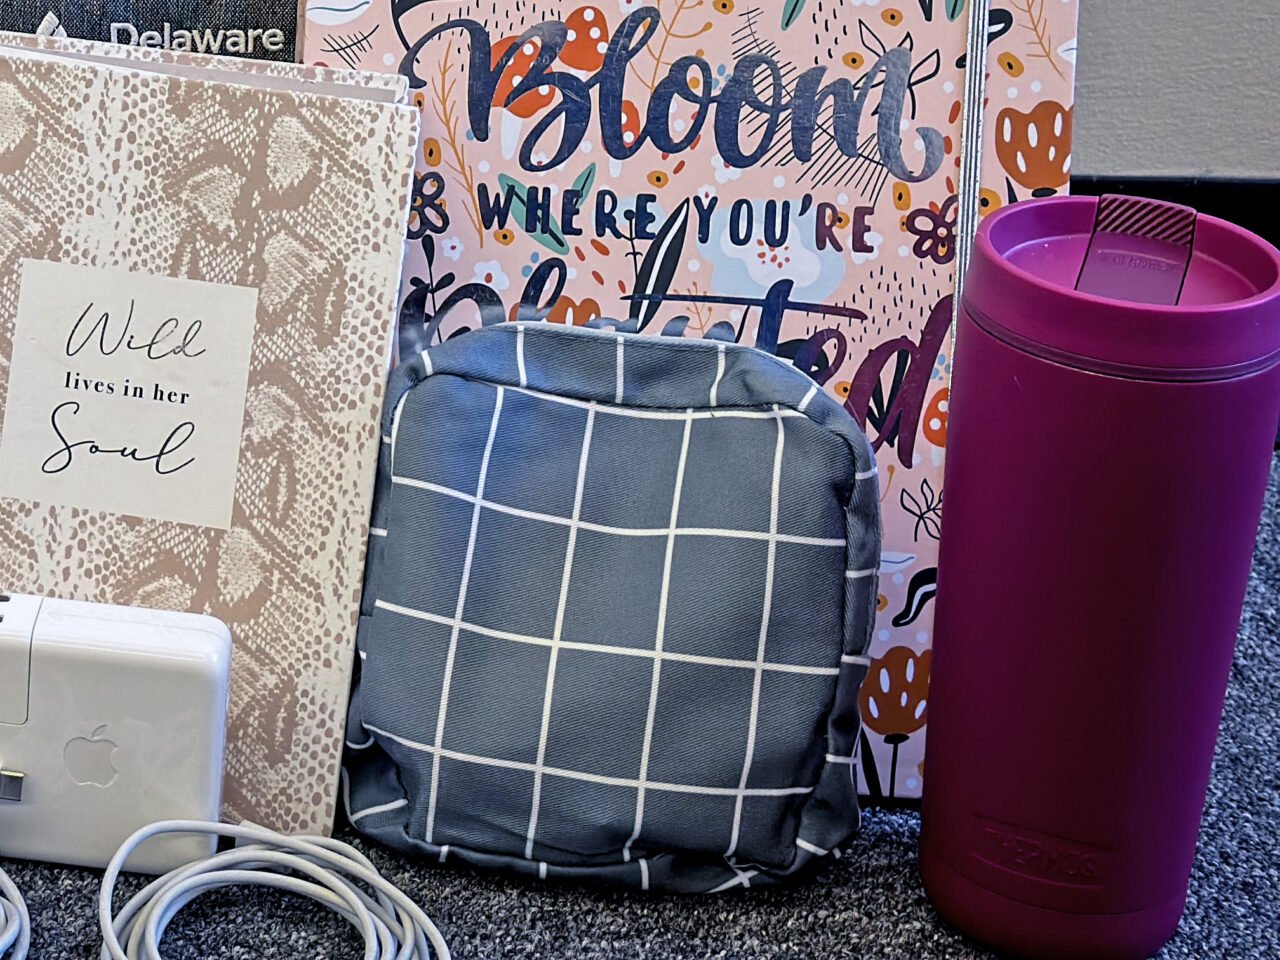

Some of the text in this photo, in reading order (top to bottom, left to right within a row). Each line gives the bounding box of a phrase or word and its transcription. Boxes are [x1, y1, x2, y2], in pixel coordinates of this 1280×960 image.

[110, 22, 285, 54] Delaware
[398, 6, 944, 182] Bloom
[477, 182, 875, 253] WHERE YOU'RE
[66, 298, 206, 360] Wild
[64, 371, 189, 404] lives in her
[41, 401, 195, 474] Soul
